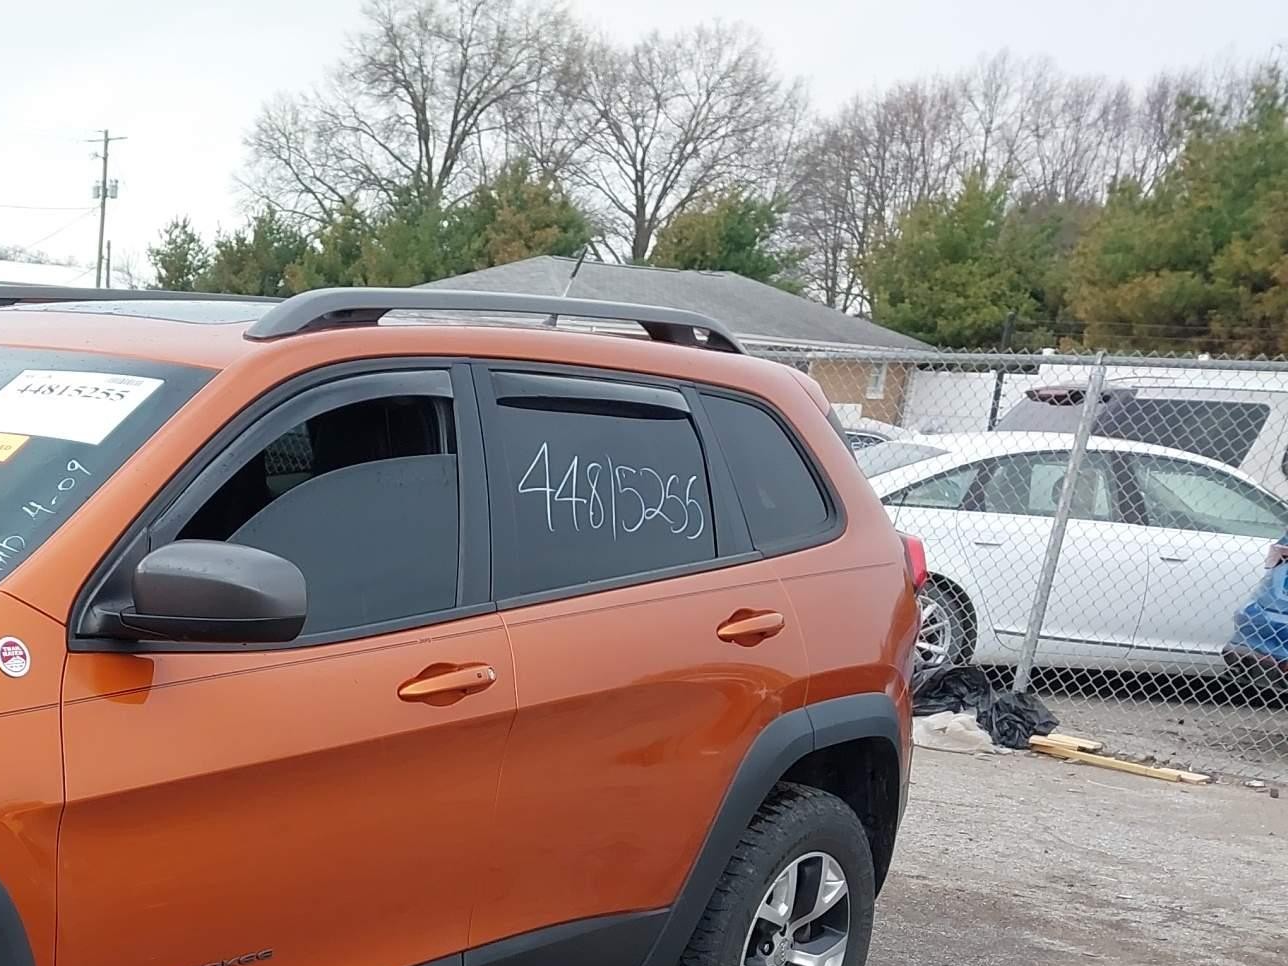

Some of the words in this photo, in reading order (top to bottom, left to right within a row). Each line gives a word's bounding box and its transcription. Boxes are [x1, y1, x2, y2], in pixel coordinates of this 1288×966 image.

[16, 383, 131, 401] 44815255
[22, 459, 92, 518] 4-09
[518, 441, 705, 541] 44815255
